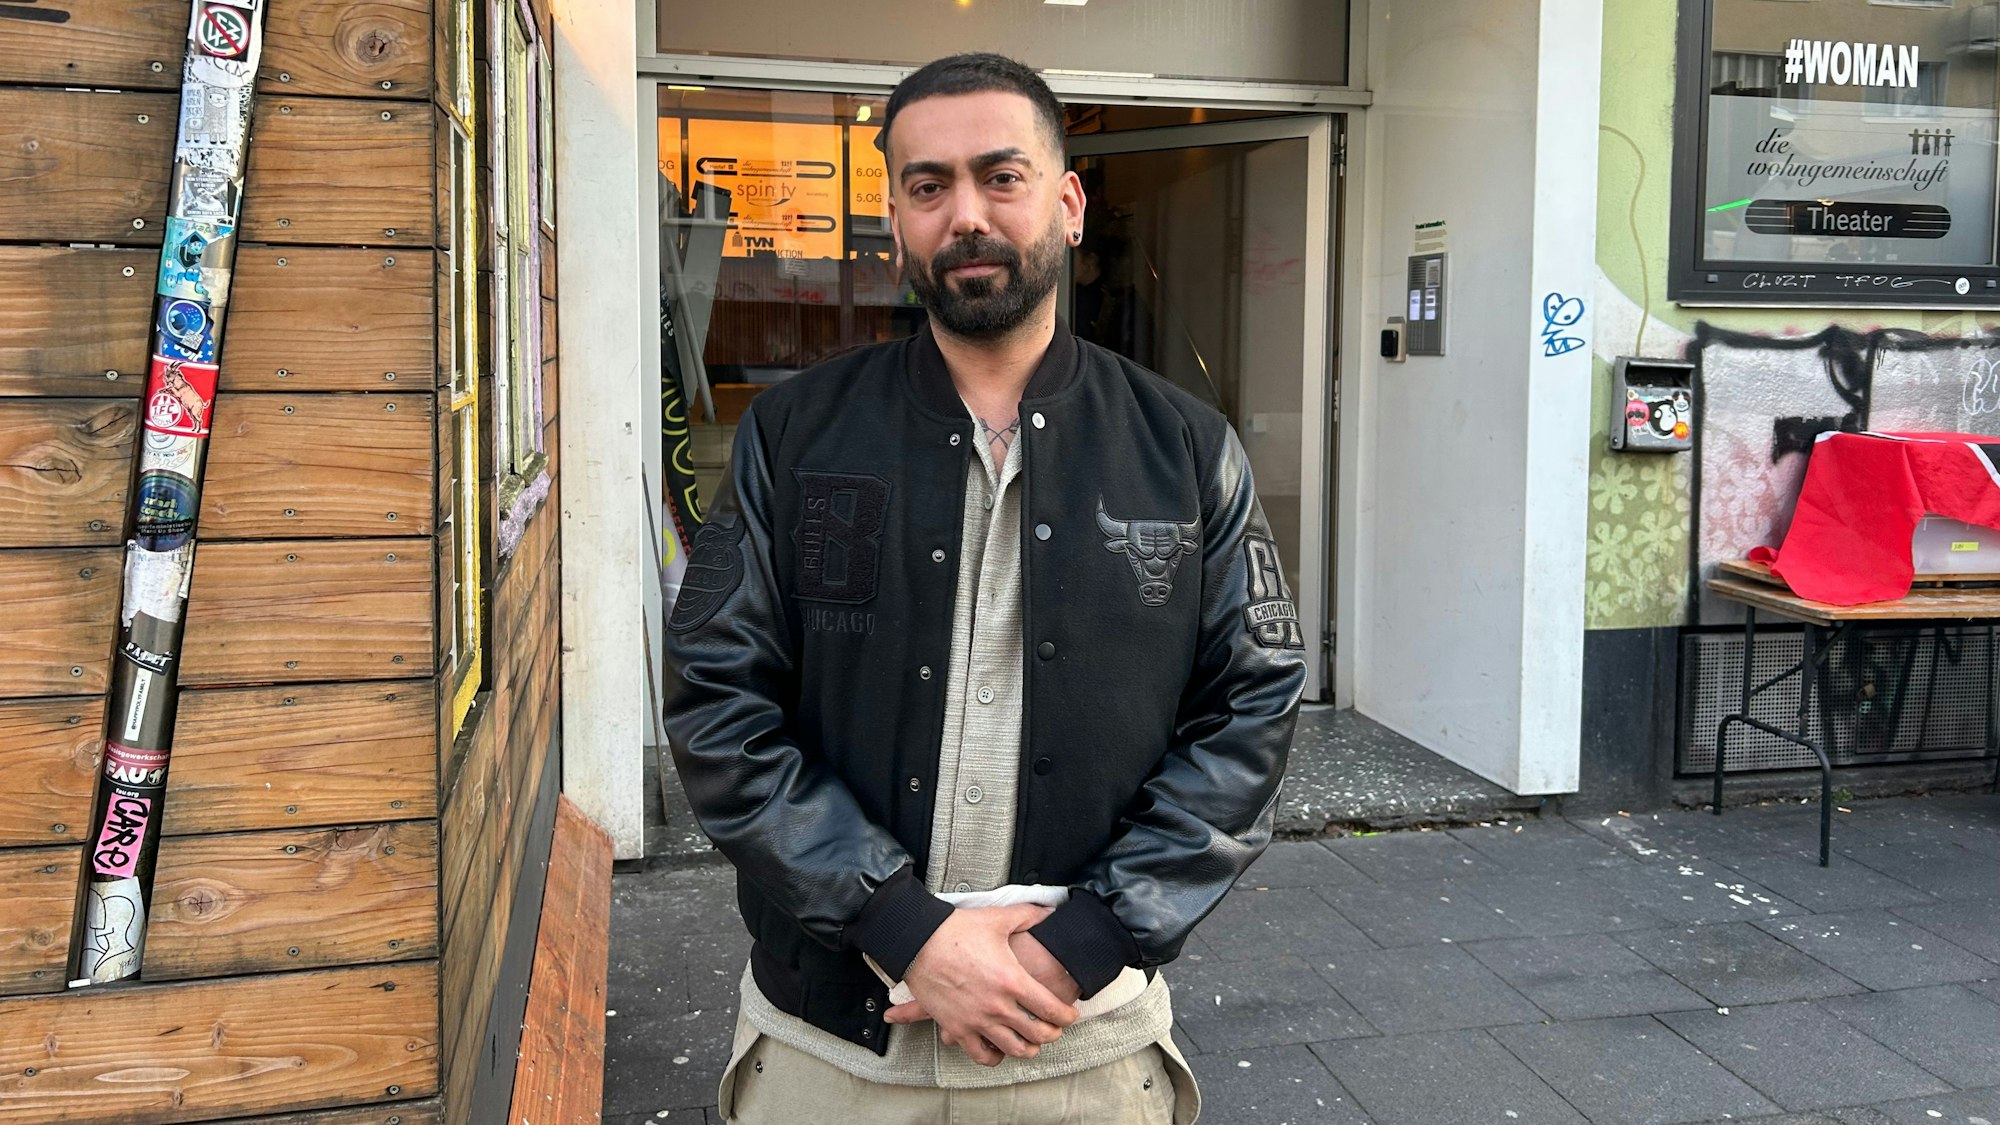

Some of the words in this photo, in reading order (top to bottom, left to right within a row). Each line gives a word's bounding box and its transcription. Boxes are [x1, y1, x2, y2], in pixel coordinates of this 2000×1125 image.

[1785, 39, 1919, 88] #WOMAN
[1755, 128, 1791, 154] die
[856, 167, 883, 178] 6.OG
[1747, 153, 1949, 191] wohngemeinschaft
[737, 180, 775, 202] spin
[781, 182, 797, 198] tv
[856, 193, 882, 203] 5.OG
[1807, 207, 1893, 232] Theater
[744, 236, 774, 248] TVN
[1254, 603, 1295, 621] CHICAGO
[107, 744, 170, 761] Basisgewerkschaf
[105, 759, 148, 784] FAU
[115, 788, 140, 798] fau.org
